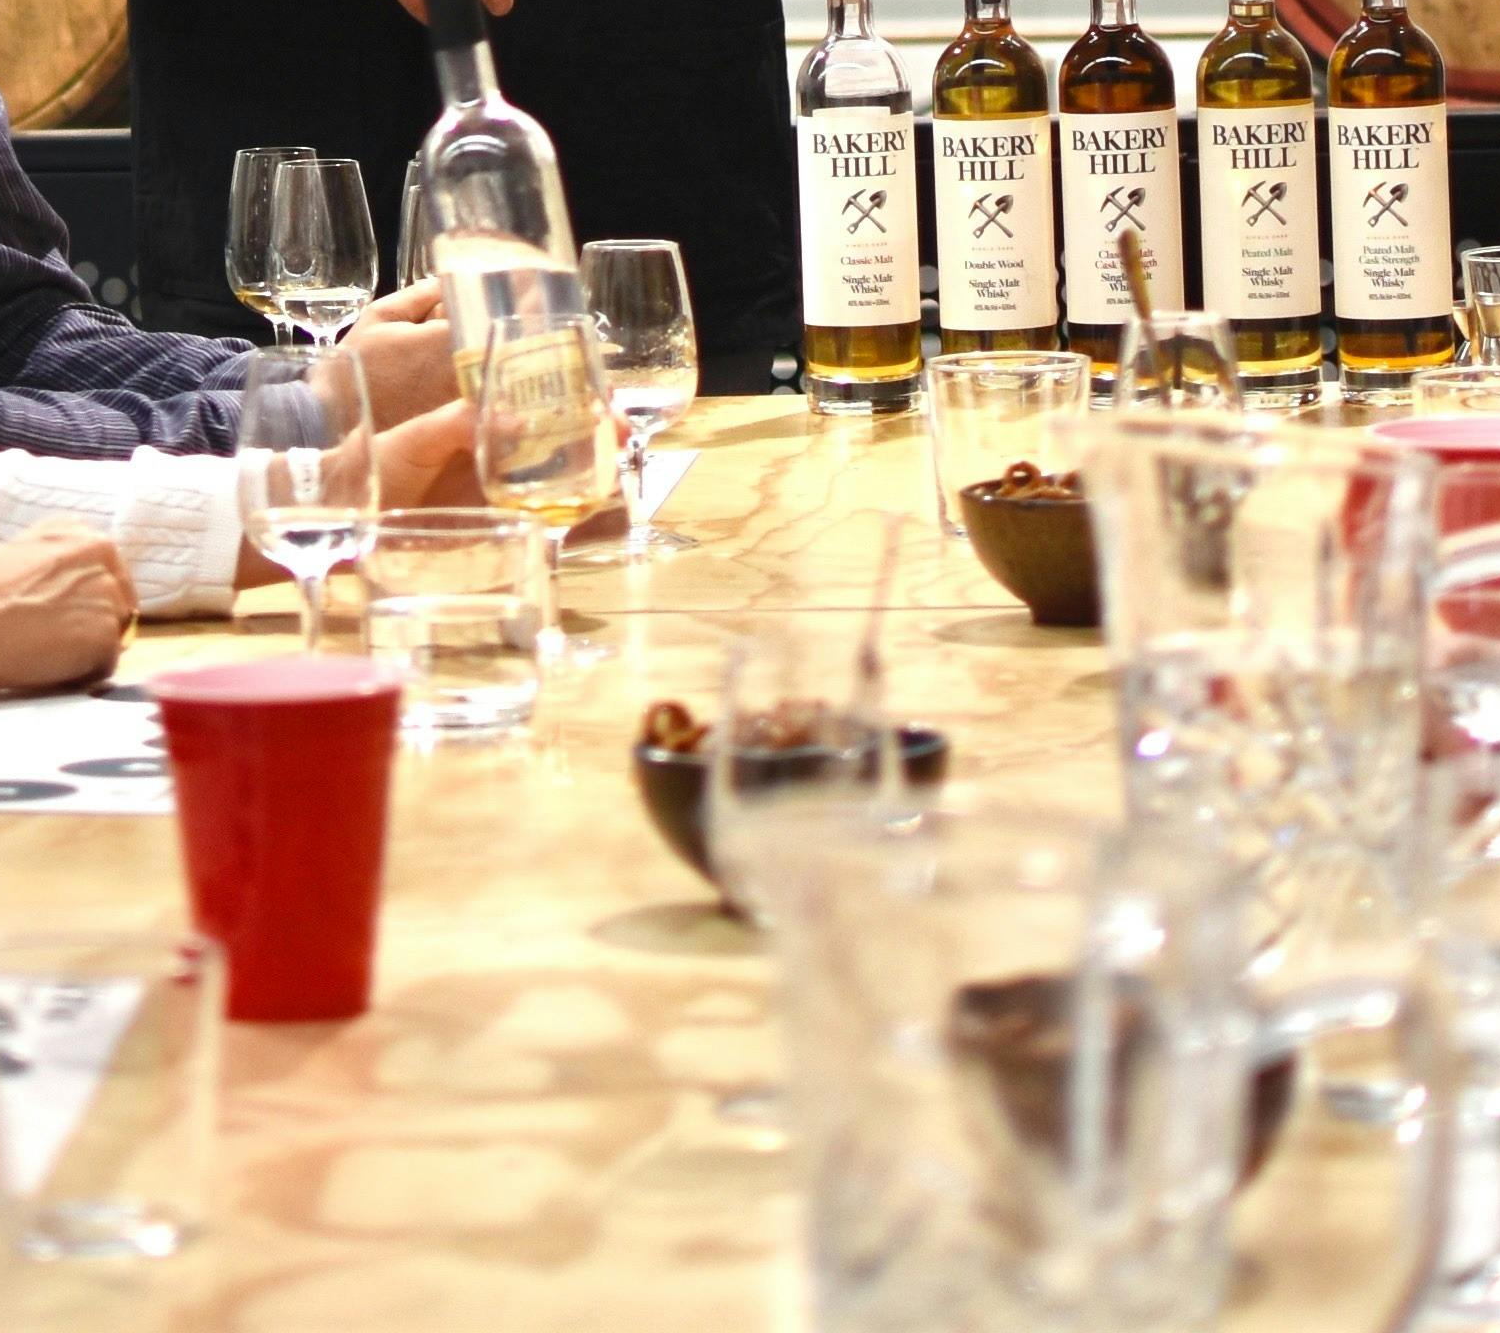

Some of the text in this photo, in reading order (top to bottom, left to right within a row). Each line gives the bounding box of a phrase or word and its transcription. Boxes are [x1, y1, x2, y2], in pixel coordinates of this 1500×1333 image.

[1072, 126, 1169, 151] BAKERY
[1212, 121, 1309, 146] BAKERY
[1337, 122, 1434, 146] BAKERY
[812, 129, 908, 154] BAKERY
[942, 134, 1039, 158] BAKERY
[1231, 146, 1297, 169] HILL
[1353, 147, 1420, 170] HILL
[831, 155, 897, 177] HILL
[958, 159, 1025, 181] HILL
[1089, 153, 1156, 175] HILL
[1241, 247, 1293, 258] Peated Malt
[1394, 245, 1415, 254] Malt
[840, 255, 893, 265] Classic Malt
[964, 259, 1024, 269] Double Wood
[1094, 259, 1117, 269] Cask
[1358, 255, 1379, 265] Cask
[1241, 266, 1293, 278] Single Malt
[1363, 268, 1415, 278] Single Malt
[842, 273, 893, 286] Single Malt
[969, 278, 1020, 289] Single Malt
[1250, 276, 1284, 288] Whisky
[1371, 278, 1405, 290] Whisky
[850, 284, 884, 295] Whisky
[976, 288, 1010, 300] Whisky
